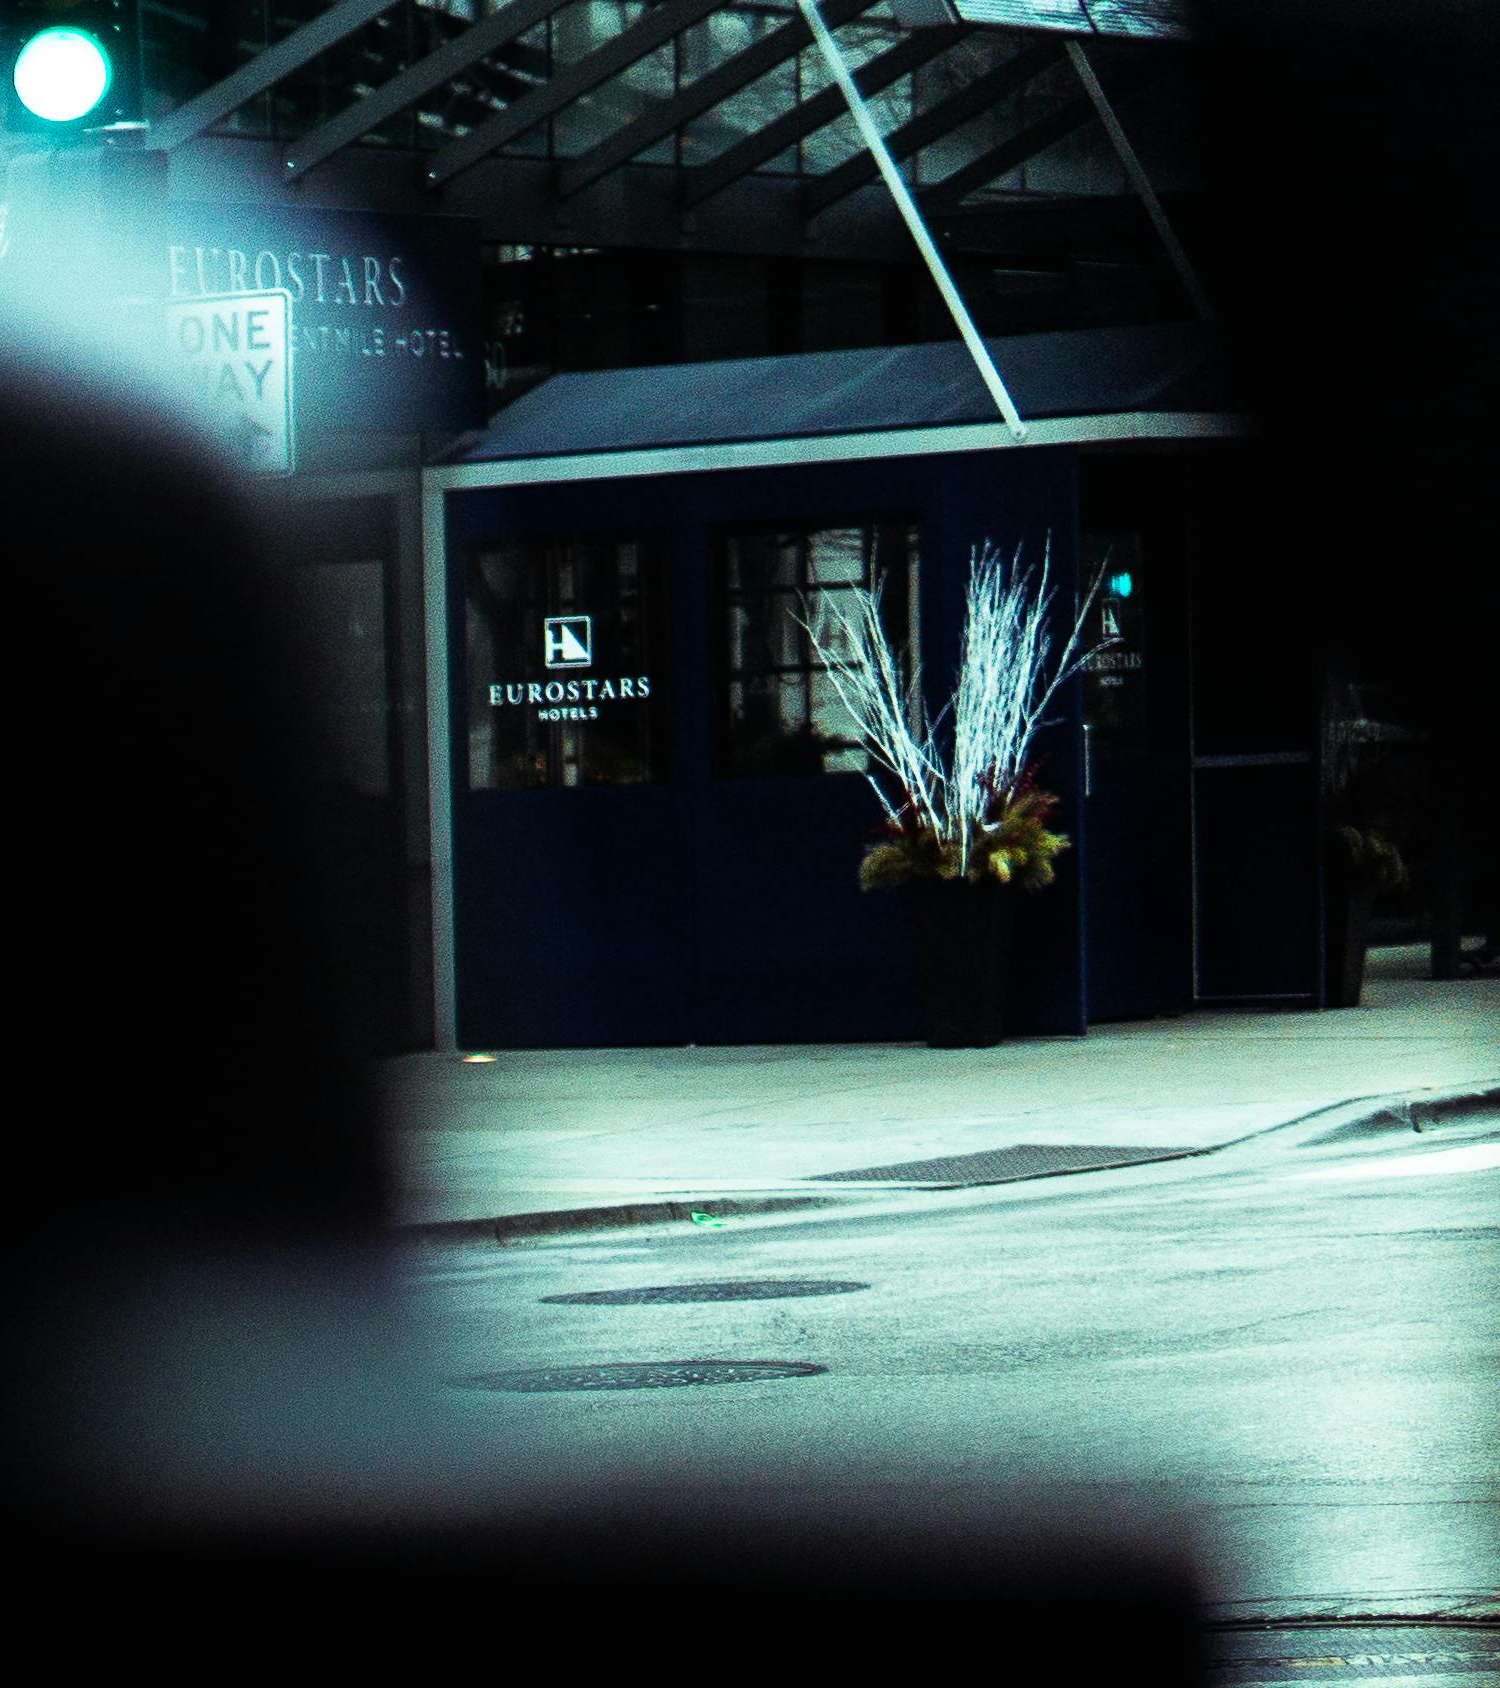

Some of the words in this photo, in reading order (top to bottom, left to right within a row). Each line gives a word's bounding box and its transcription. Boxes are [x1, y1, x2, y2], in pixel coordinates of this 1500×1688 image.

[170, 245, 408, 306] EUROSTARS
[179, 310, 270, 354] ONE
[488, 676, 652, 706] EUROSTARS
[537, 706, 599, 721] HOTELS
